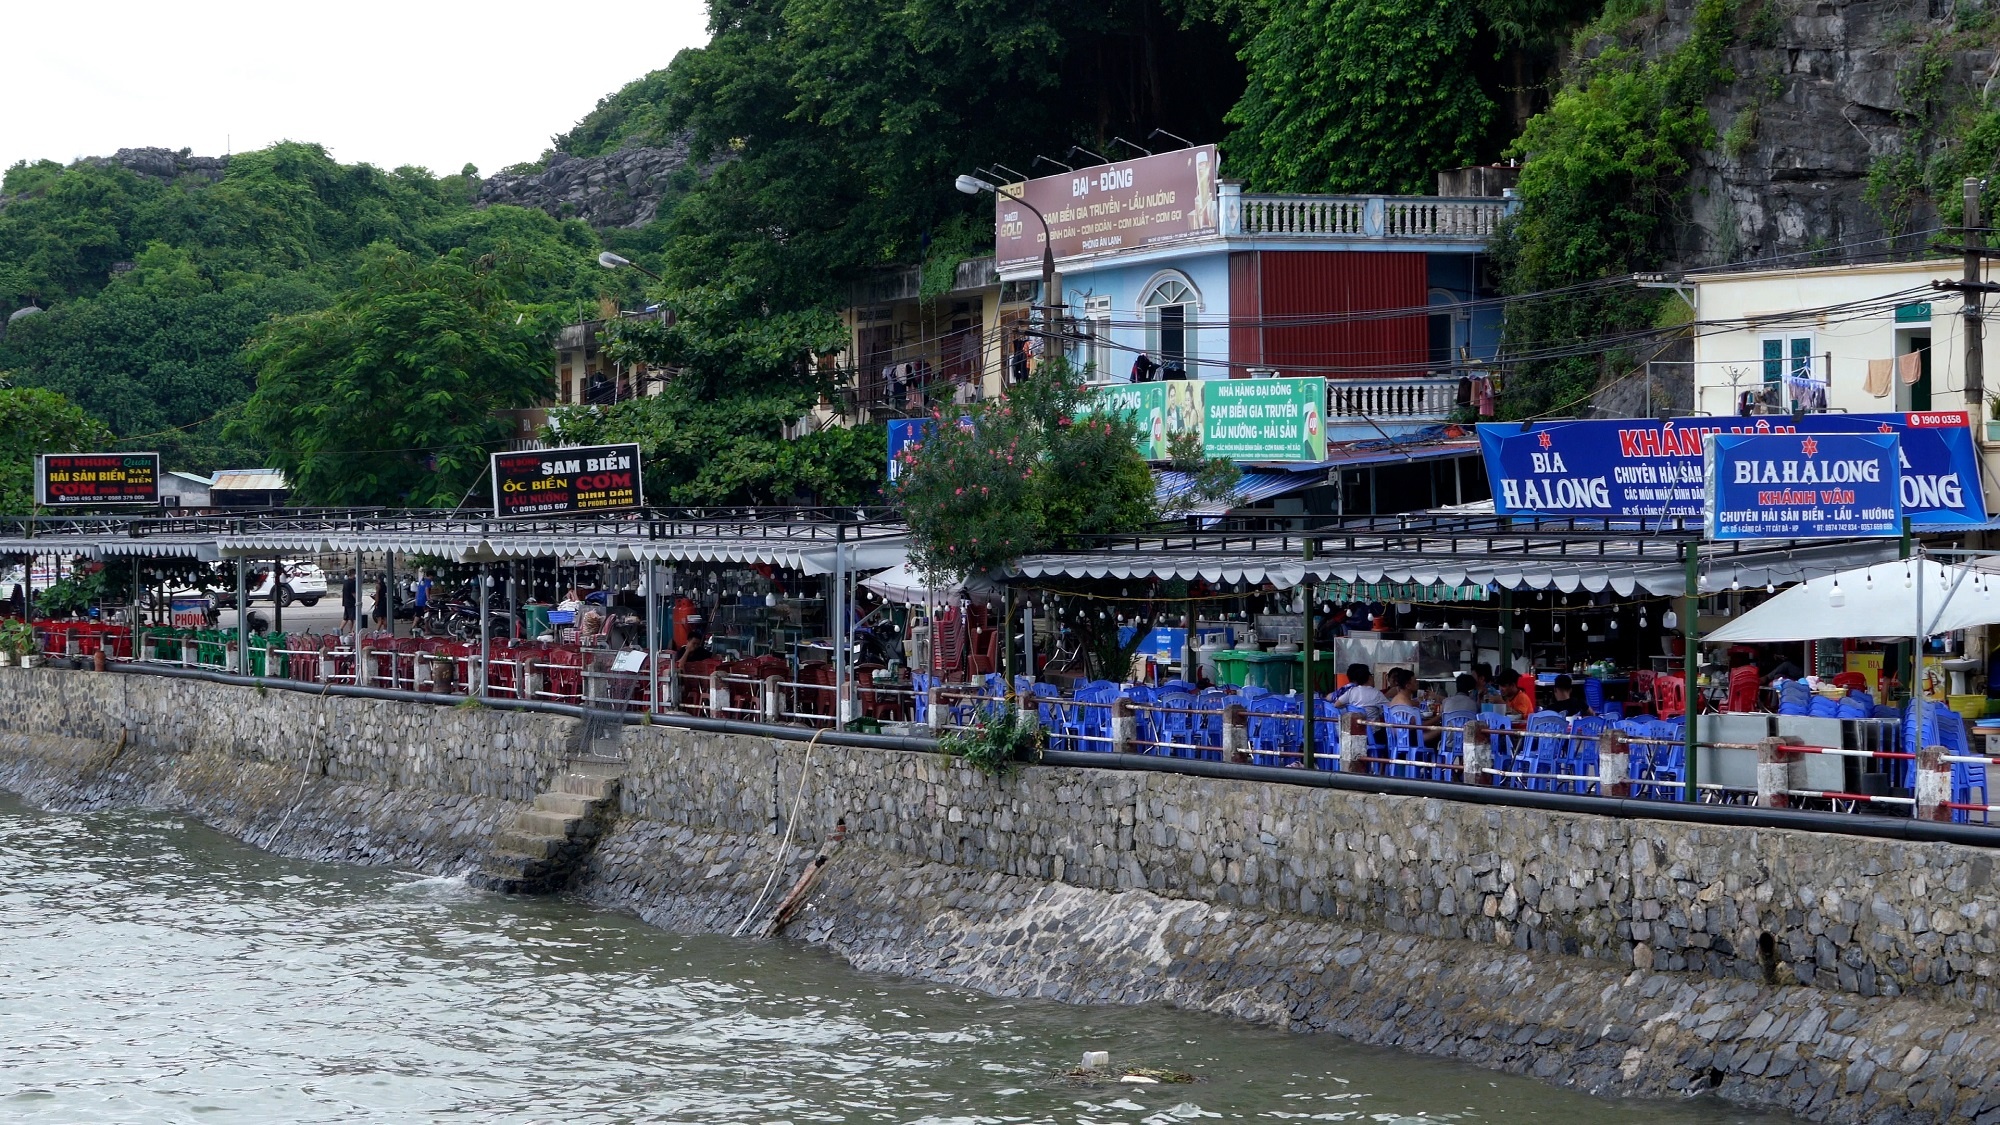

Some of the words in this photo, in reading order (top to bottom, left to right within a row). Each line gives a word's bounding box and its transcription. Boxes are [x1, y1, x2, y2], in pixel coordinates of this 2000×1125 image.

[1073, 176, 1089, 200] ĐẠI
[1100, 166, 1133, 191] ĐÔNG
[1043, 211, 1059, 225] SAM
[1060, 203, 1075, 222] BIỂN
[1076, 207, 1089, 220] GIA
[1089, 195, 1120, 217] TRUYỀN
[1129, 190, 1145, 211] LẨU
[1146, 189, 1176, 208] NƯỚNG
[1001, 222, 1023, 237] GOLD
[1036, 233, 1047, 243] CƠ
[1081, 224, 1095, 235] CƠM
[1118, 218, 1132, 229] CƠM
[1155, 211, 1170, 223] CƠM
[1219, 383, 1234, 397] NHÀ
[1235, 382, 1255, 397] HÀNG
[1256, 385, 1269, 398] ĐẠI
[1270, 382, 1292, 396] ĐÔNG
[1211, 405, 1228, 418] SAM
[1229, 398, 1248, 418] BIỂN
[1249, 405, 1264, 418] GIA
[1265, 398, 1298, 418] TRUYỀN
[1211, 418, 1227, 438] LẨU
[1228, 421, 1258, 438] NƯỚNG
[1264, 419, 1279, 438] HẢI
[1280, 419, 1298, 438] SẢN
[1921, 416, 1940, 424] 1900
[1941, 415, 1962, 424] 0358
[1618, 422, 1721, 458] KHÁN
[541, 460, 581, 475] SAM
[586, 451, 631, 472] BIỂN
[1531, 452, 1567, 473] BIA
[50, 469, 70, 482] HẢI
[72, 468, 96, 481] SẢN
[98, 467, 126, 481] BIỂN
[127, 475, 153, 484] BIỂN
[576, 472, 632, 491] CƠM
[1614, 462, 1657, 484] CHUYÊN
[1658, 461, 1679, 484] HẢI
[1680, 461, 1703, 483] SẢN
[50, 482, 96, 496] CƠM
[503, 479, 527, 492] ỐC
[531, 475, 568, 490] BIỂN
[1900, 473, 1965, 508] ONG
[1624, 486, 1638, 501] CÁC
[1638, 486, 1654, 501] MÓN
[1674, 486, 1691, 501] BÌNH
[1758, 487, 1816, 506] KHÁNH
[1820, 486, 1855, 505] VÂN
[1720, 508, 1759, 523] CHUYÊN
[1762, 507, 1778, 522] HẢI
[1780, 507, 1799, 522] SẢN
[1802, 505, 1824, 521] BIỂN
[1834, 504, 1852, 521] LẨU
[1862, 506, 1895, 520] NƯỚNG
[1868, 660, 1880, 669] BIA
